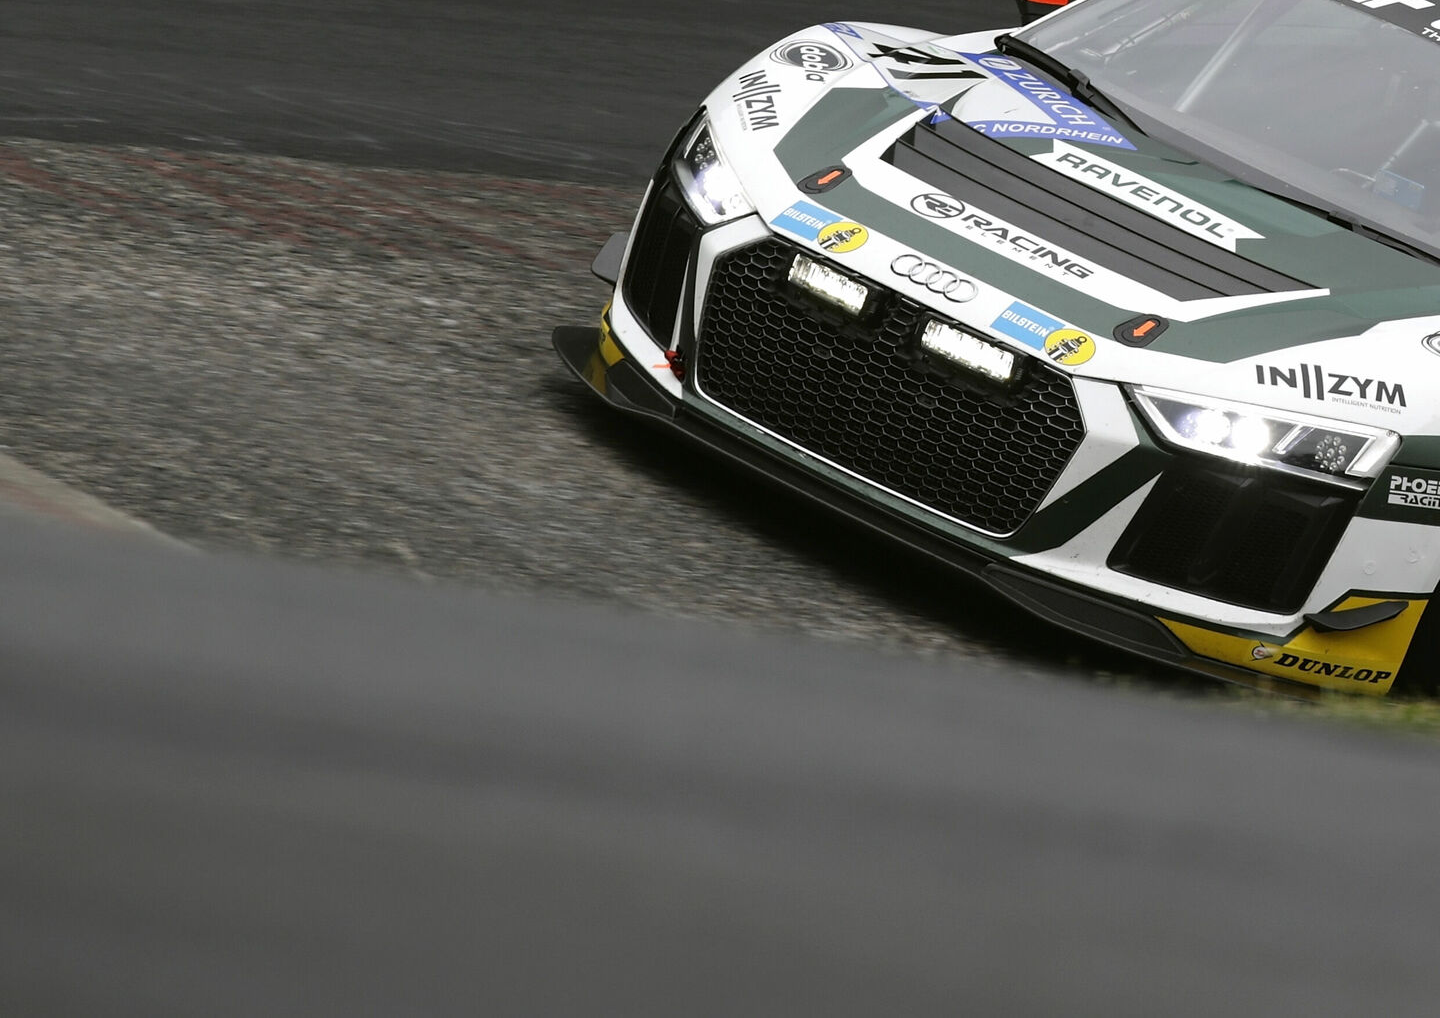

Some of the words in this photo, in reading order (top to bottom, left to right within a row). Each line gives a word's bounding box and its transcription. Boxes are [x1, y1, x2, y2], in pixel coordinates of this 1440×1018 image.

[799, 44, 829, 83] dobla
[1004, 71, 1096, 125] ZURICH
[991, 122, 1123, 145] NORDRHEIN
[1055, 152, 1228, 239] RAVENOL
[782, 207, 827, 230] BILSTEIN
[960, 213, 1095, 280] RACING
[966, 225, 1069, 277] ELEMENT
[1002, 310, 1050, 339] BILSTEIN
[1273, 653, 1392, 684] DUNLOP
